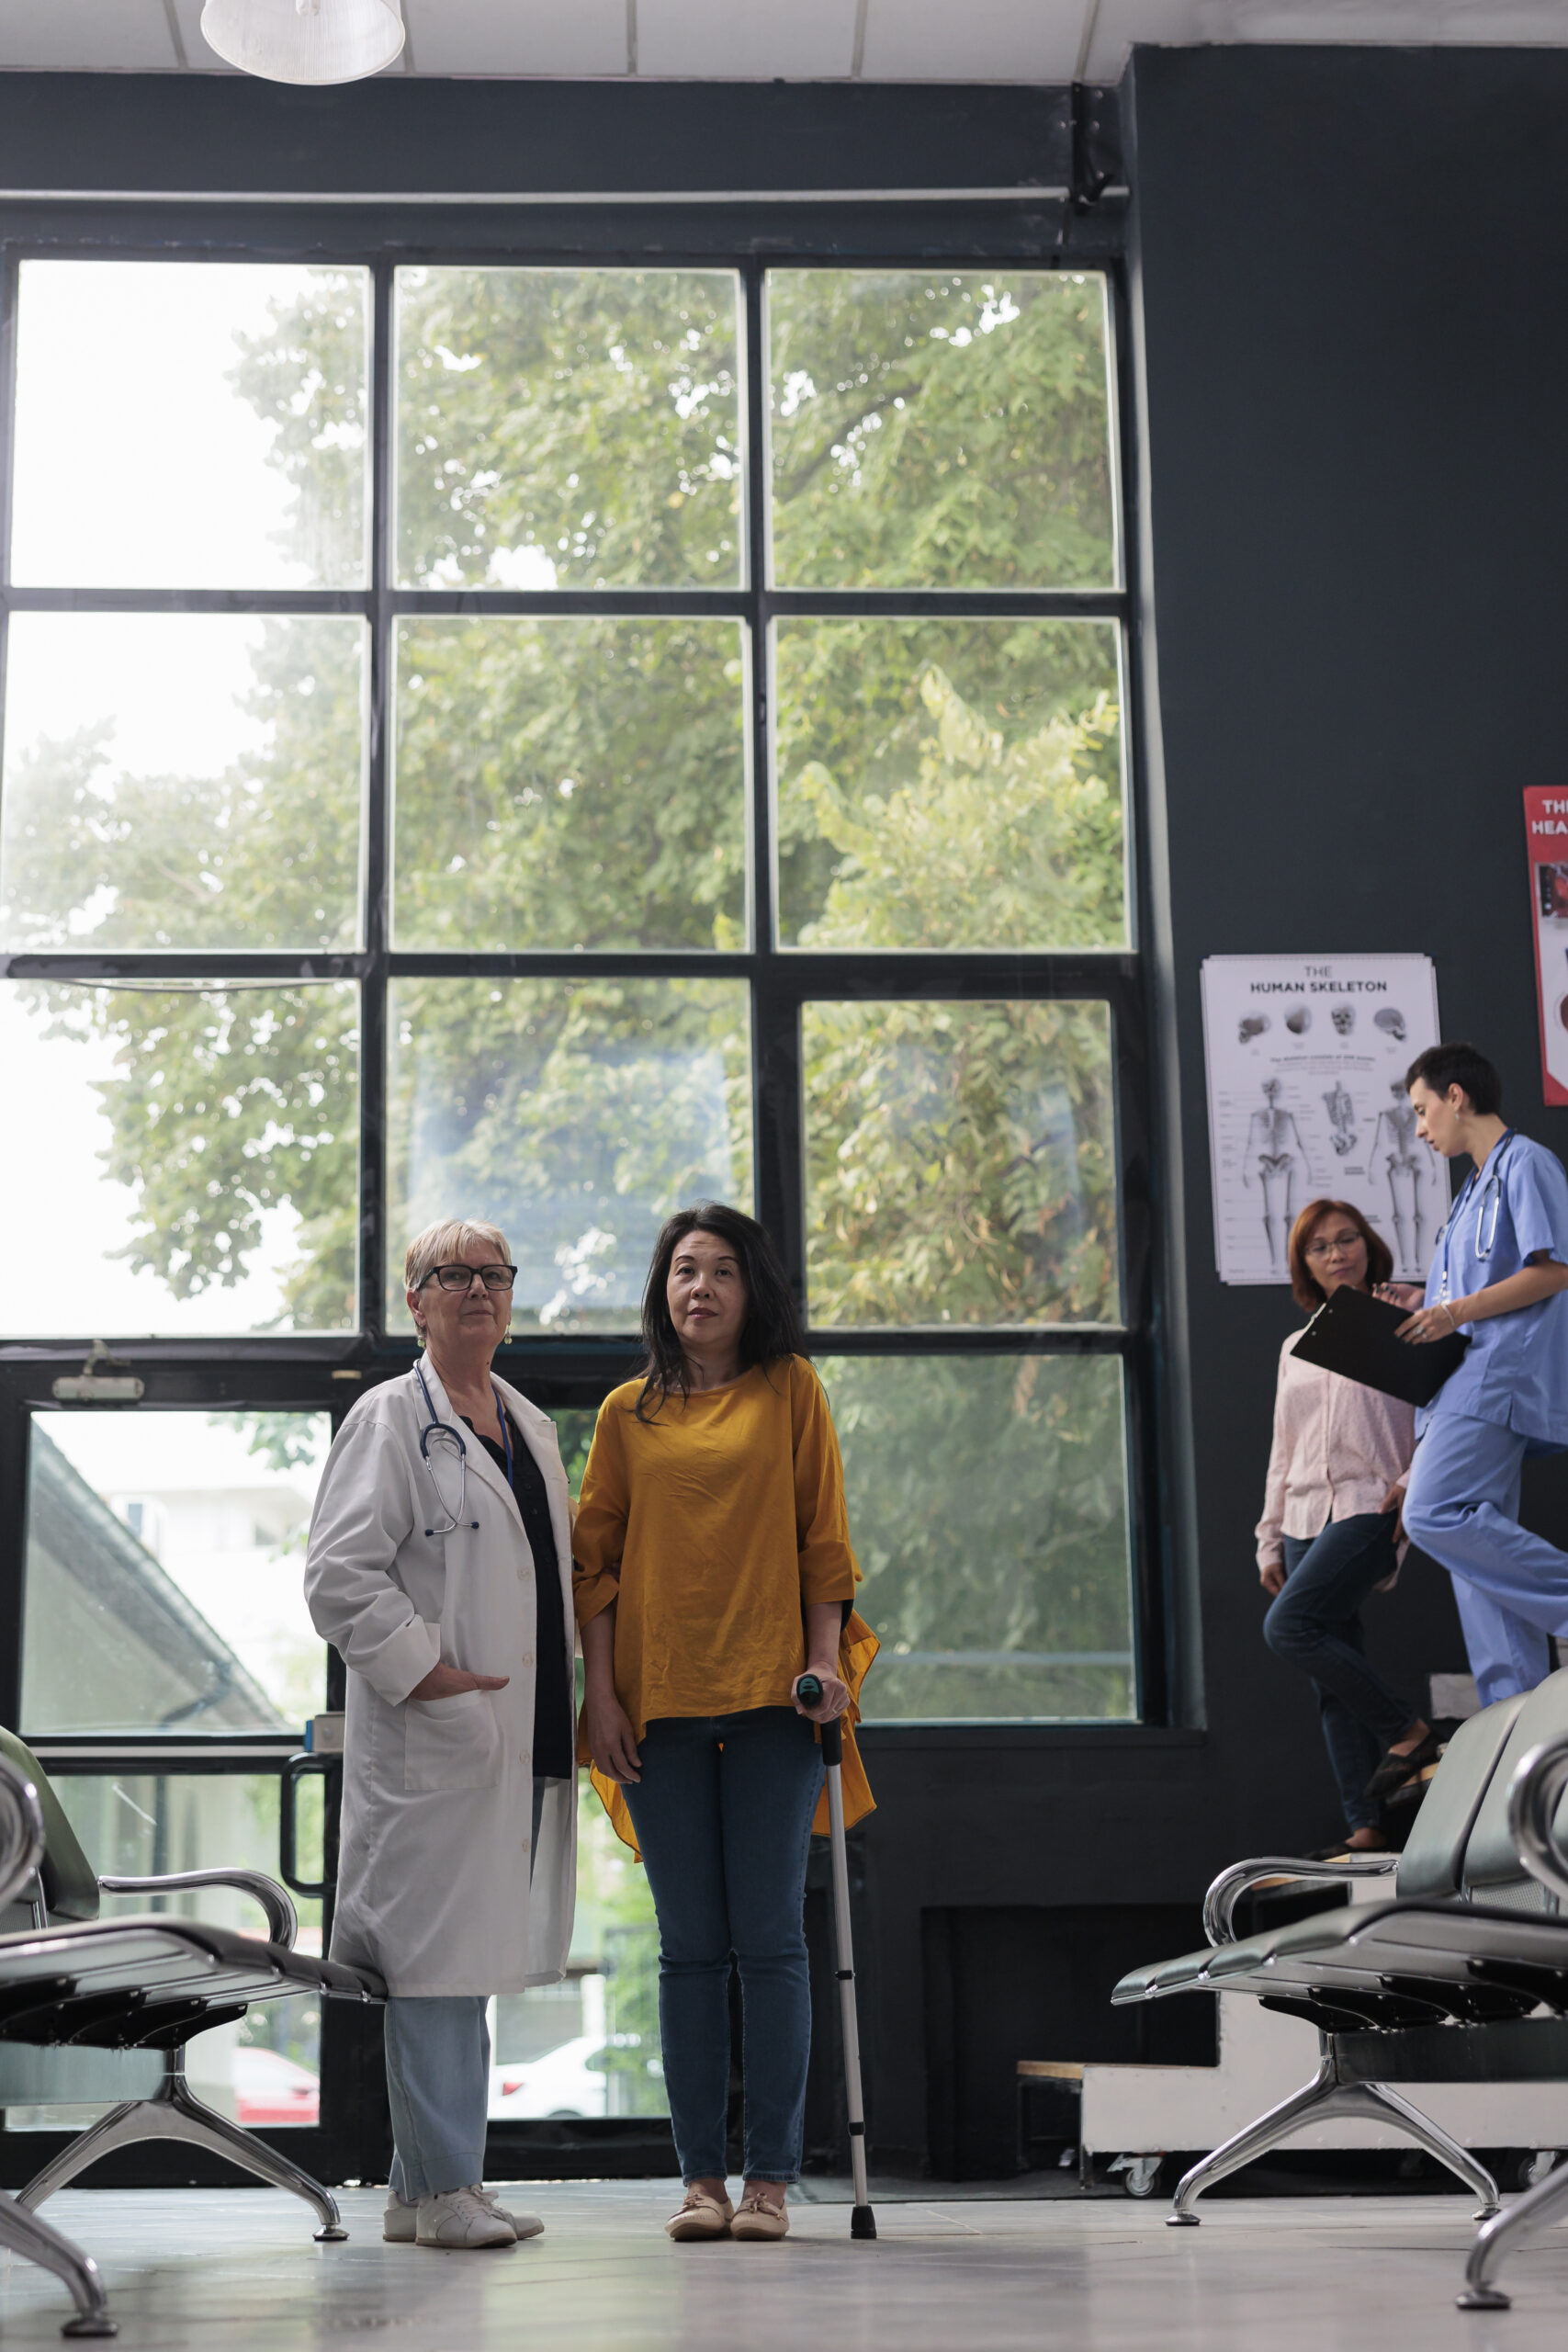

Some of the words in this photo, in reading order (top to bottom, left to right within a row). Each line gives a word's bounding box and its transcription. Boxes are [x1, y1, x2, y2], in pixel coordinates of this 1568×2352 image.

[1541, 799, 1568, 815] TH
[1304, 966, 1333, 978] THE
[1250, 981, 1305, 993] HUMAN
[1310, 980, 1387, 993] SKELETON
